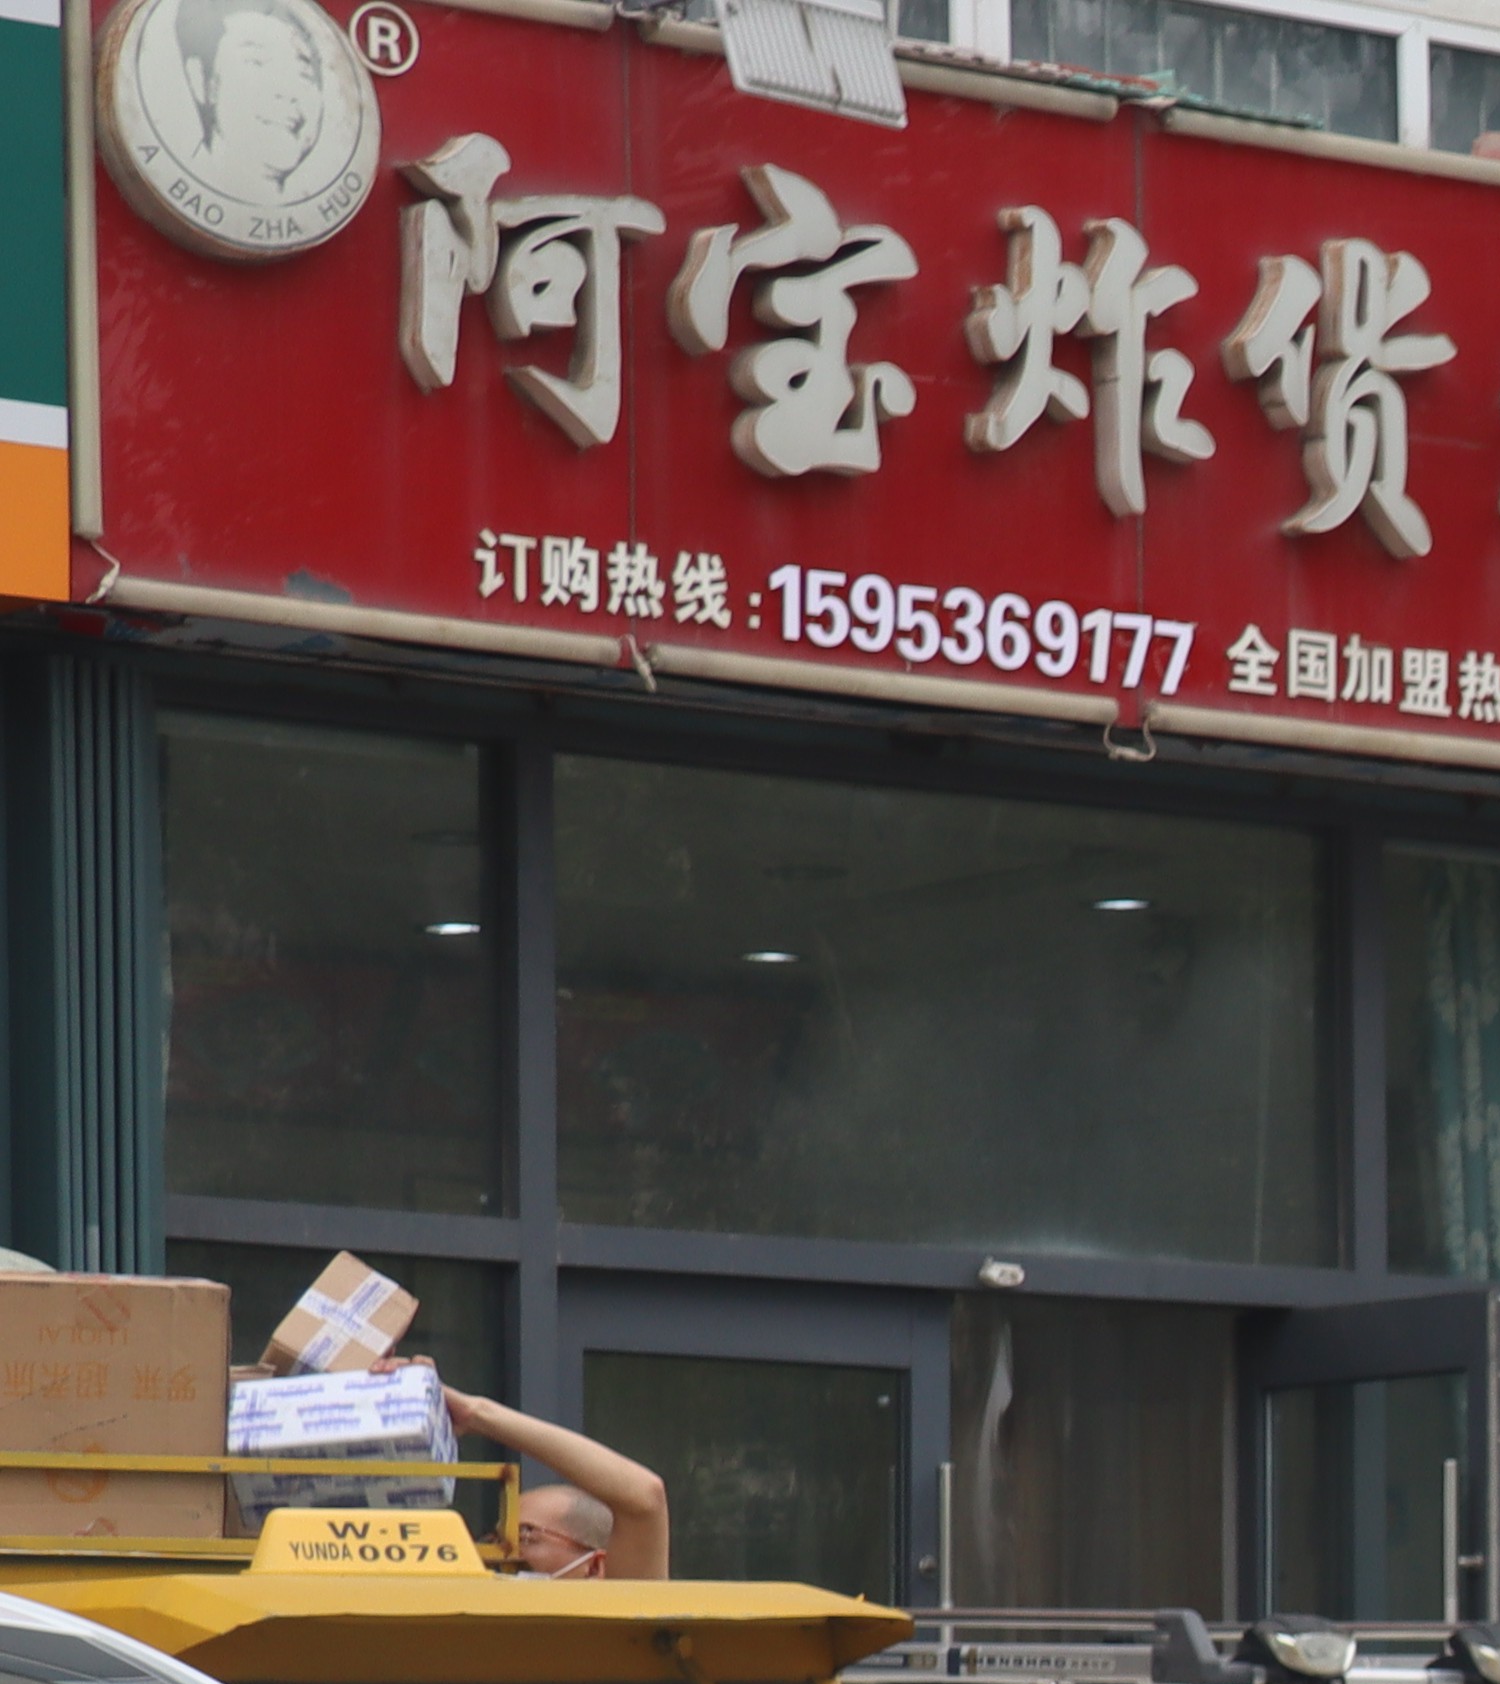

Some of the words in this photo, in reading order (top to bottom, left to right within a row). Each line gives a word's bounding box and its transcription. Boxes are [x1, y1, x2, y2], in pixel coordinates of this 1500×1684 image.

[138, 143, 160, 165] A
[167, 179, 225, 226] BAO
[249, 217, 304, 241] ZHA
[316, 171, 364, 224] HUO
[289, 1542, 353, 1561] YUNDA
[358, 1544, 458, 1562] 0076
